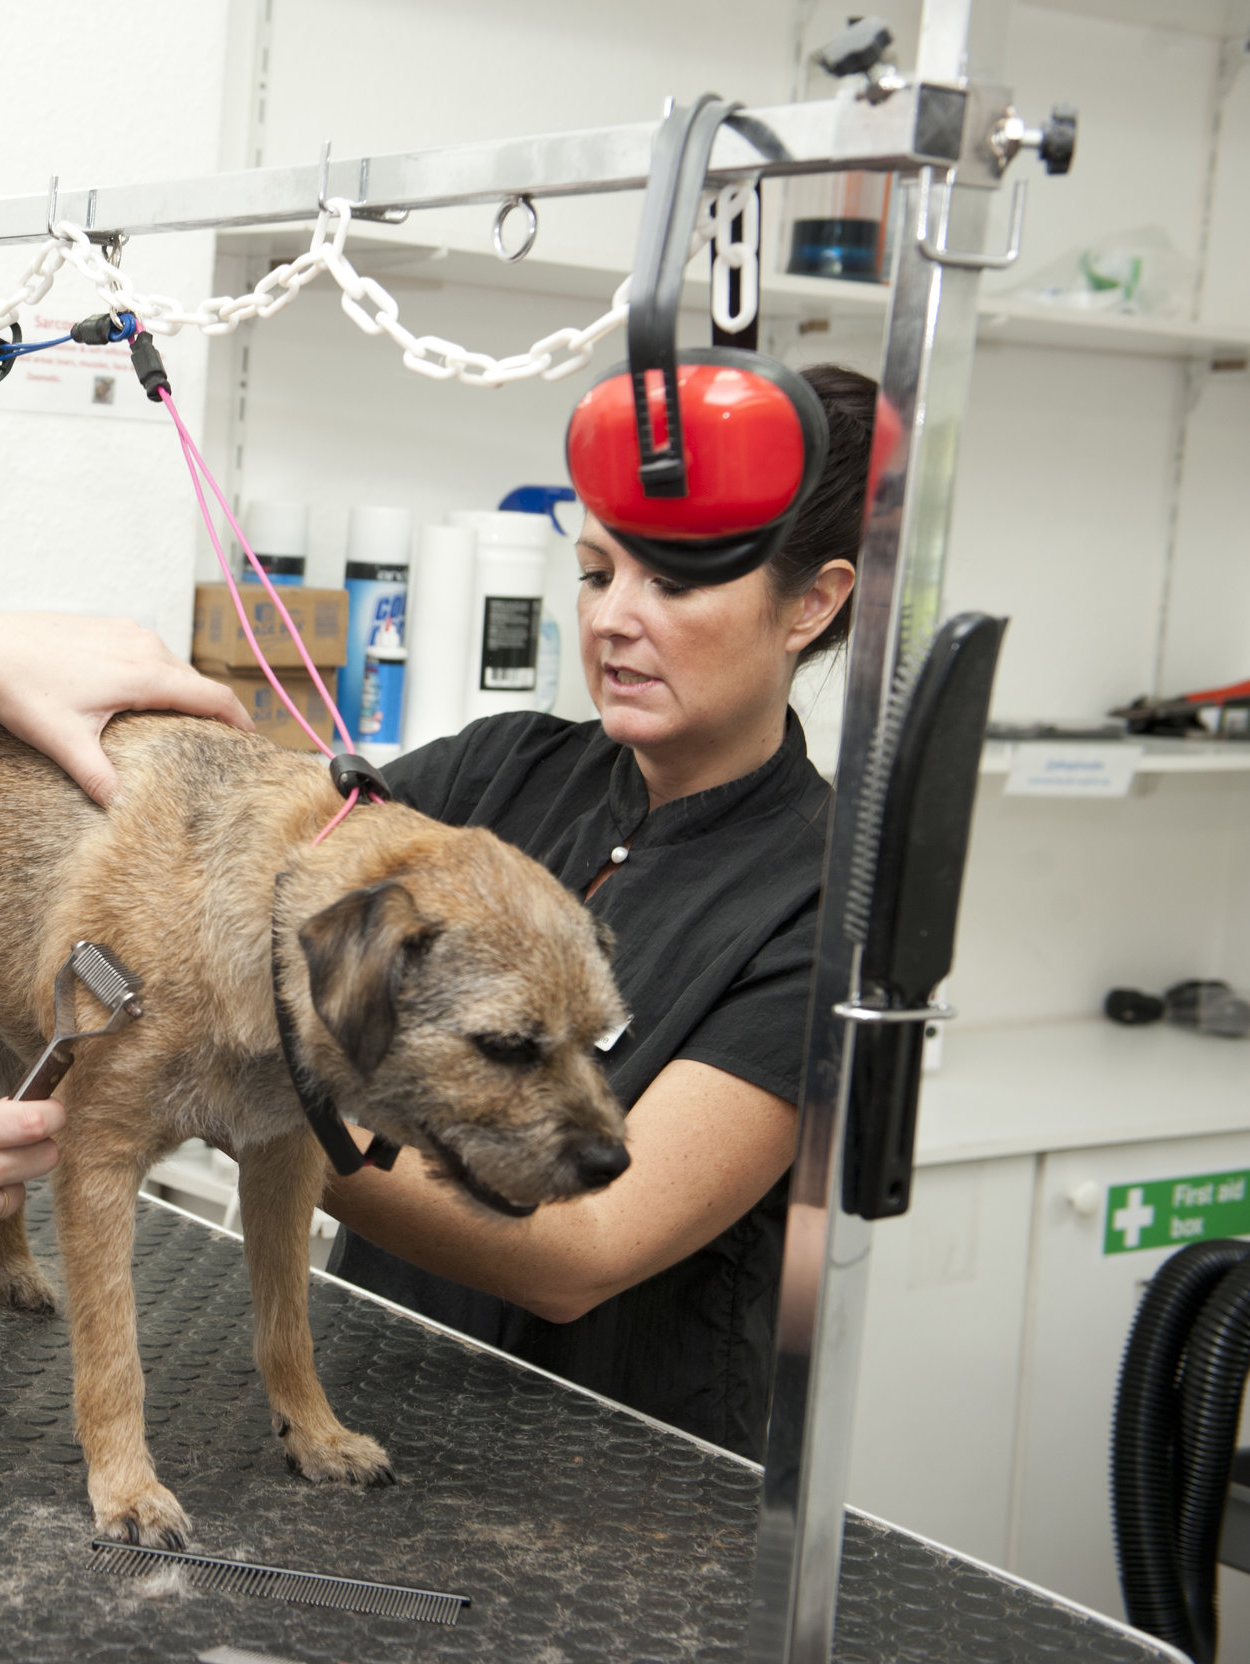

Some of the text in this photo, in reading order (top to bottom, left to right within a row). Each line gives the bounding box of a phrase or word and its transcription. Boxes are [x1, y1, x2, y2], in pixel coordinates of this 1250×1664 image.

[1173, 1177, 1246, 1208] First aid
[1171, 1215, 1204, 1239] box
